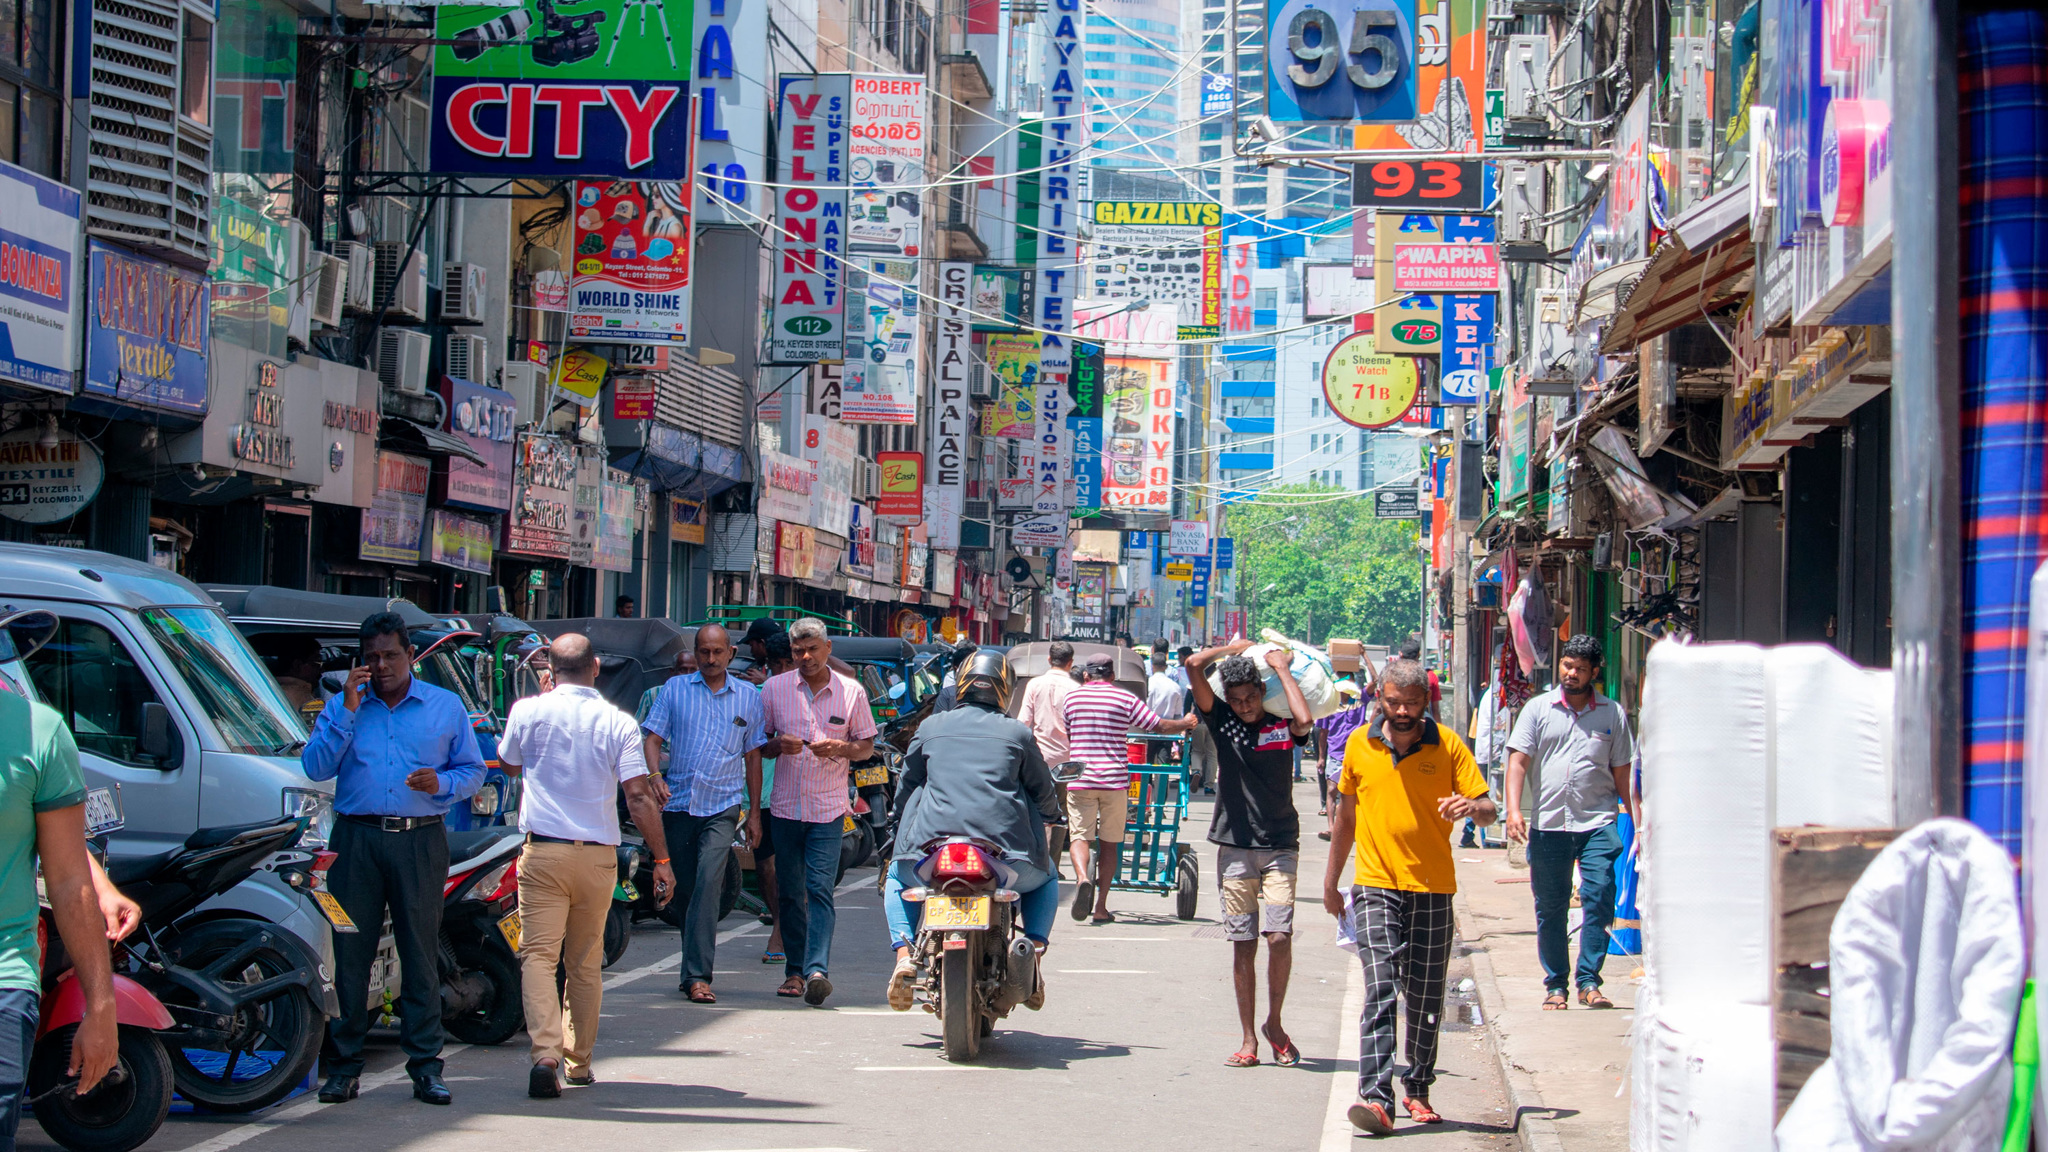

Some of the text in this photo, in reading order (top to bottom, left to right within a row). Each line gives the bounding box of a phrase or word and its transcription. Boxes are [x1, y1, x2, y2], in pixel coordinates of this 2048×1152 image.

[1287, 8, 1401, 89] 95
[855, 79, 921, 95] ROBERT
[446, 83, 680, 169] CITY
[850, 145, 886, 155] AGENCIES
[910, 147, 922, 157] LTD
[1371, 161, 1462, 199] 93
[781, 94, 822, 305] VELONNA
[822, 96, 842, 305] SUPER MARKET
[1096, 202, 1220, 225] GAZZALYS
[1409, 248, 1487, 263] WAAPPA
[1, 241, 62, 301] BONANZA
[1205, 229, 1220, 325] GAZZALYS
[1398, 267, 1496, 279] EATING HOUSE
[98, 254, 204, 353] JAYANTHI
[578, 291, 630, 307] WORLD
[634, 293, 680, 310] SHINE
[1043, 271, 1064, 347] TEX
[574, 316, 602, 326] dishtv
[577, 306, 631, 314] Communication
[645, 309, 679, 317] Networks
[795, 320, 822, 333] 112
[1073, 311, 1173, 349] TOKYO
[1401, 325, 1437, 340] 75
[773, 340, 842, 349] 112, KEYZER STREET,
[117, 335, 175, 382] Textile
[625, 346, 655, 365] 124
[785, 350, 830, 360] COLOMBO-11.
[1352, 355, 1391, 364] Sheema
[576, 367, 599, 384] Cash
[938, 268, 965, 484] CRYSTAL PALACE
[1356, 366, 1388, 375] Watch
[1077, 360, 1094, 415] LUCKY
[1452, 375, 1481, 394] 79
[1151, 362, 1173, 486] TOKYO
[1036, 390, 1058, 498] JUNIOR MAX
[1074, 420, 1091, 506] FASHIONS
[895, 472, 916, 480] Cash
[33, 485, 68, 493] KEYZER
[1148, 491, 1168, 505] 86
[946, 913, 980, 924] 9594
